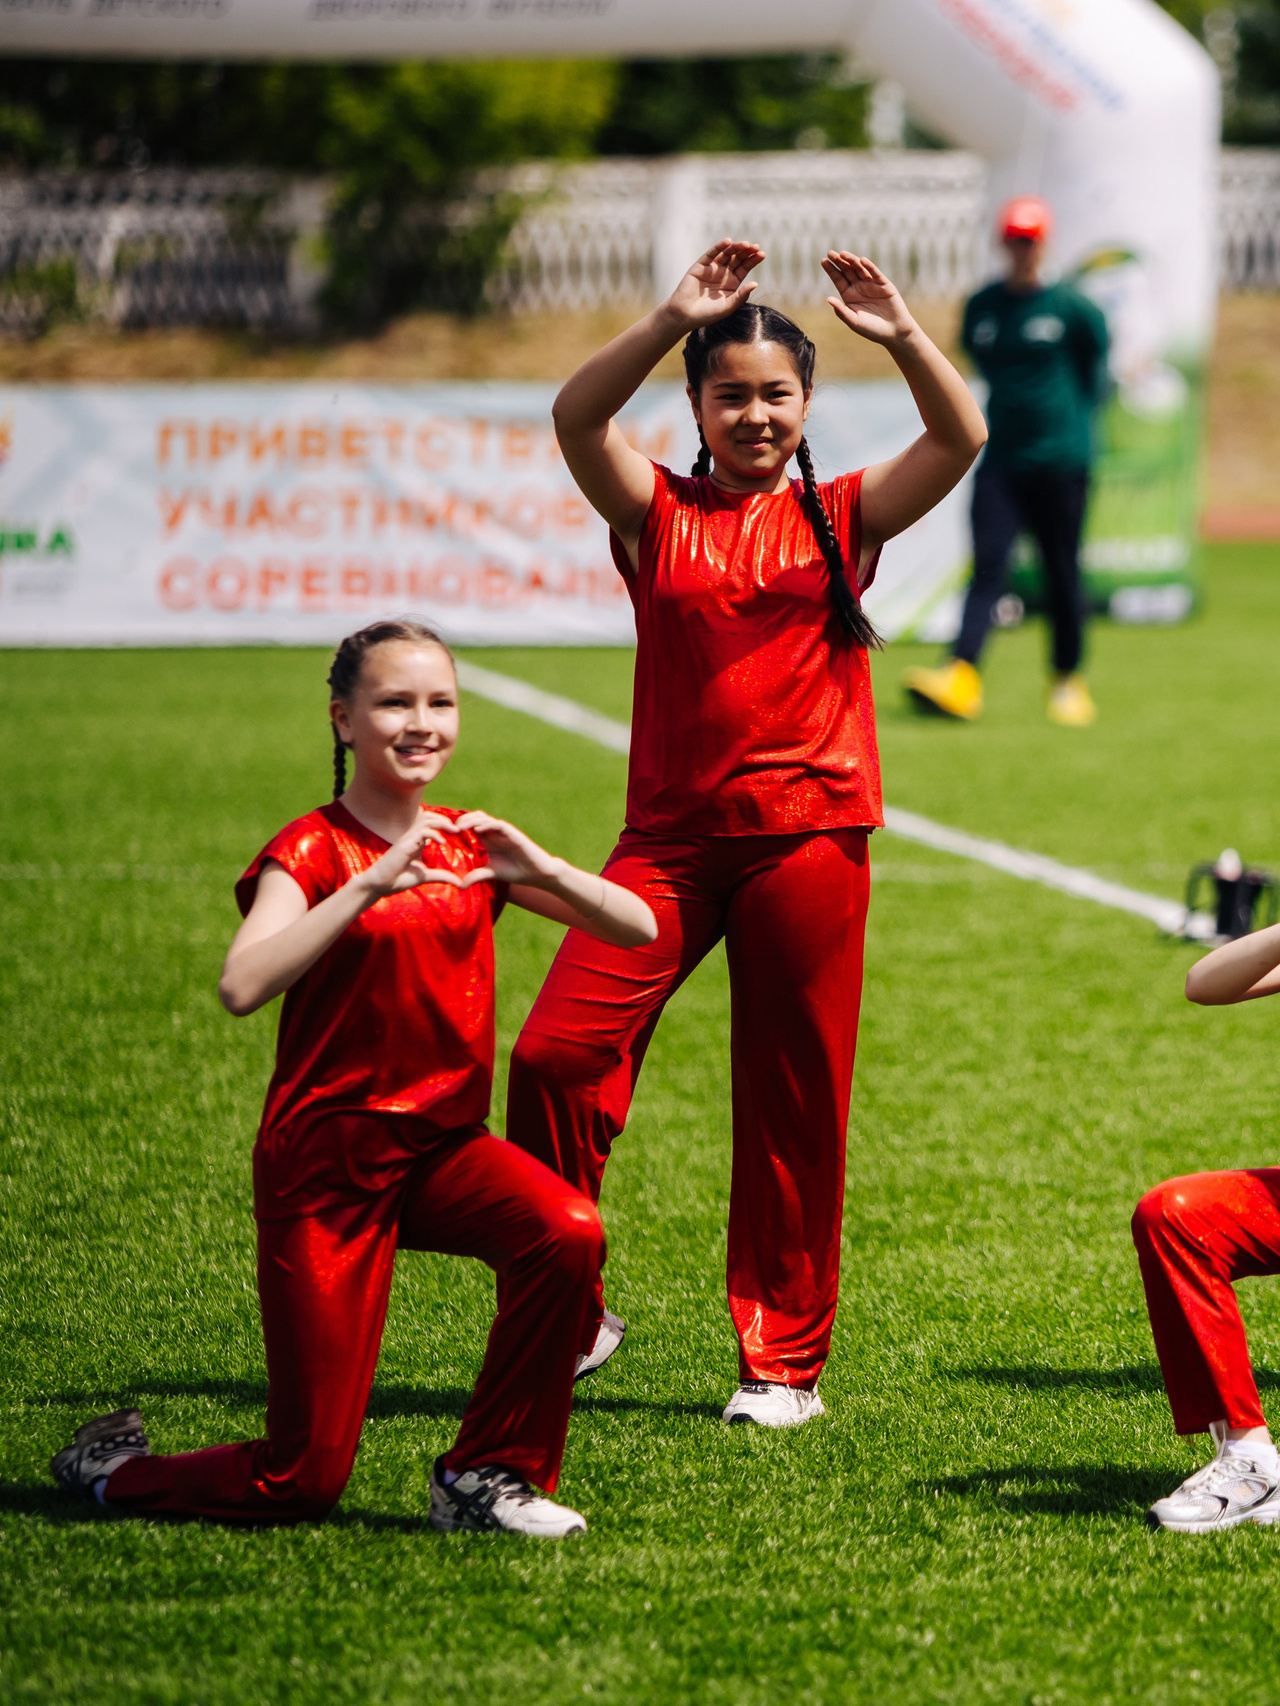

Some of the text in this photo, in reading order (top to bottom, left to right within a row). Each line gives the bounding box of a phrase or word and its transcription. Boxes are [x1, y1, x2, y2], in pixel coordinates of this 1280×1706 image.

[155, 415, 674, 470] ПРИВЕТСТВМ
[156, 486, 593, 541] УЧАСТНИКОВ
[156, 555, 631, 611] СОРЕВНОВАН
